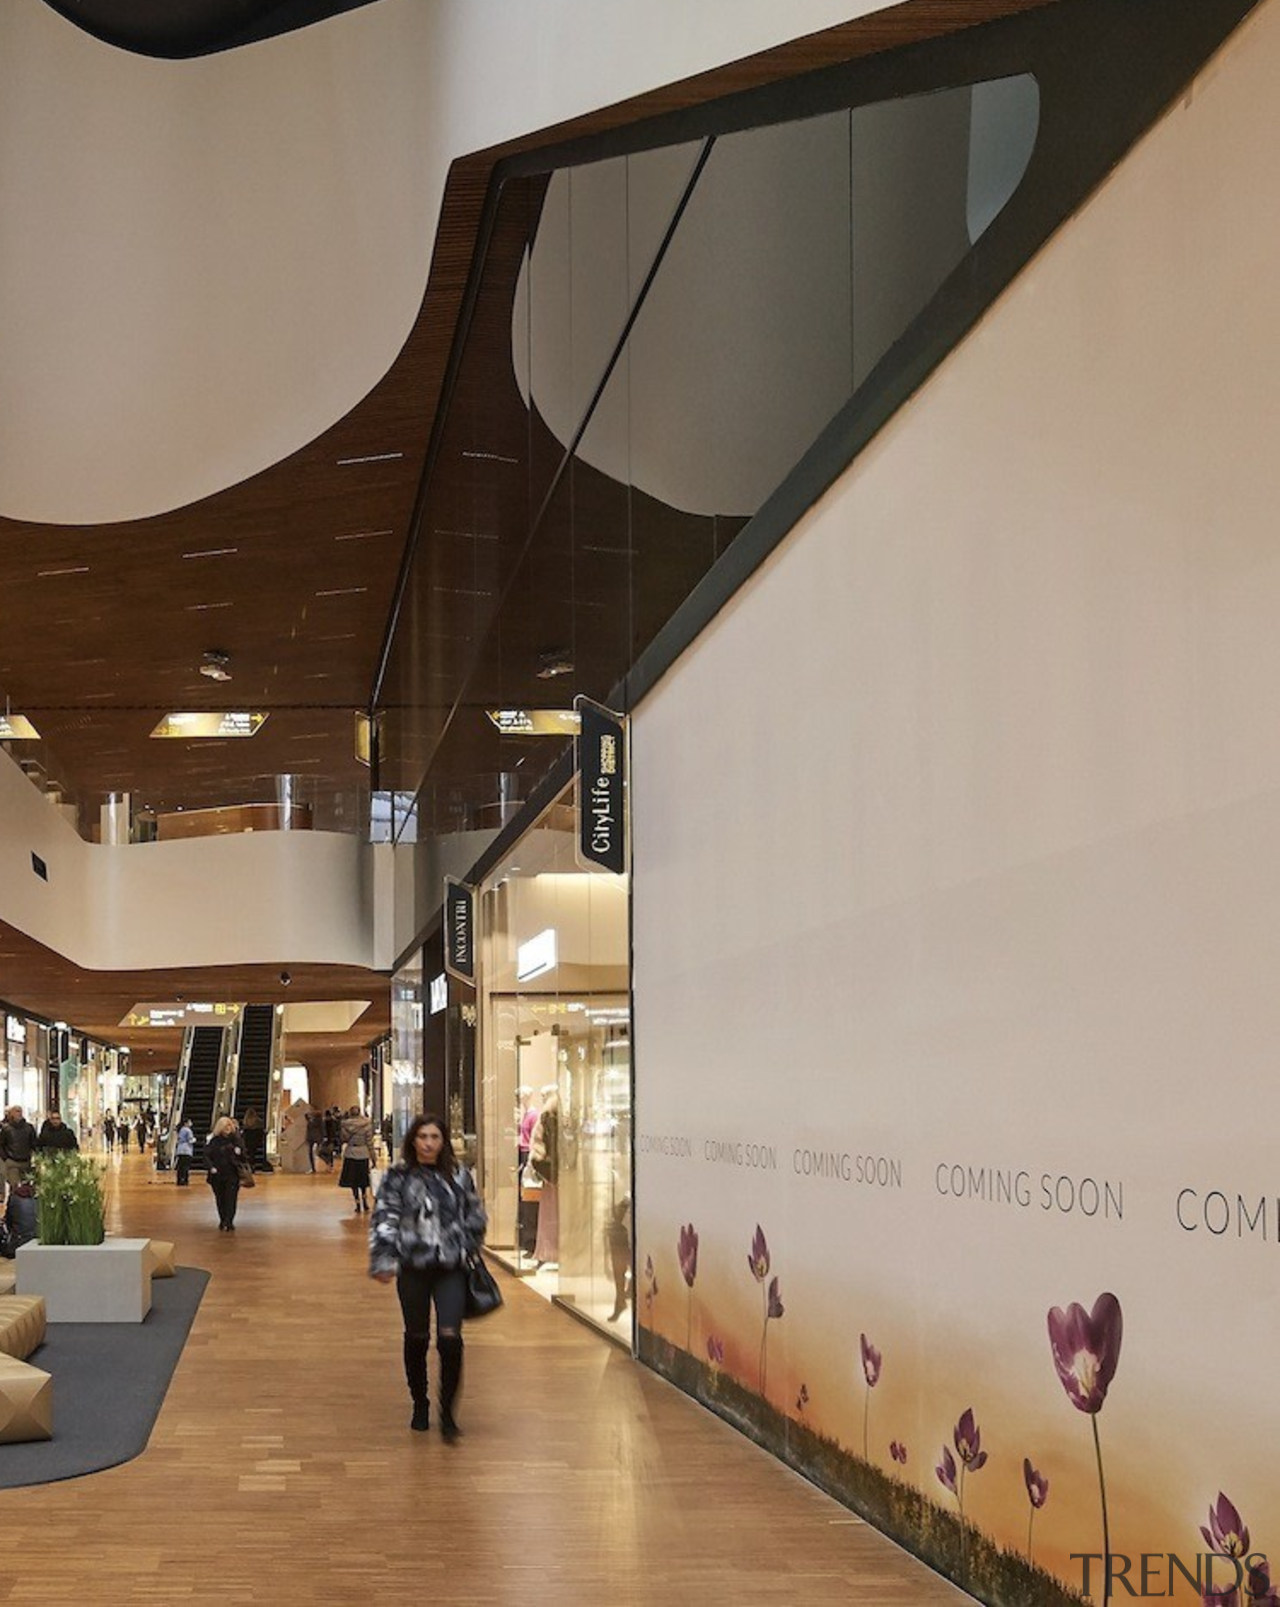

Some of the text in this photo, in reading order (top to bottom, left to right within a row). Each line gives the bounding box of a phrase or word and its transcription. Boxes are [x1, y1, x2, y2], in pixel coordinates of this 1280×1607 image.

[591, 776, 615, 853] CityLife
[640, 1134, 692, 1158] COMING SOON
[703, 1140, 777, 1170] COMING SOON
[792, 1148, 902, 1189] COMING SOON
[935, 1162, 1123, 1220] COMING SOON
